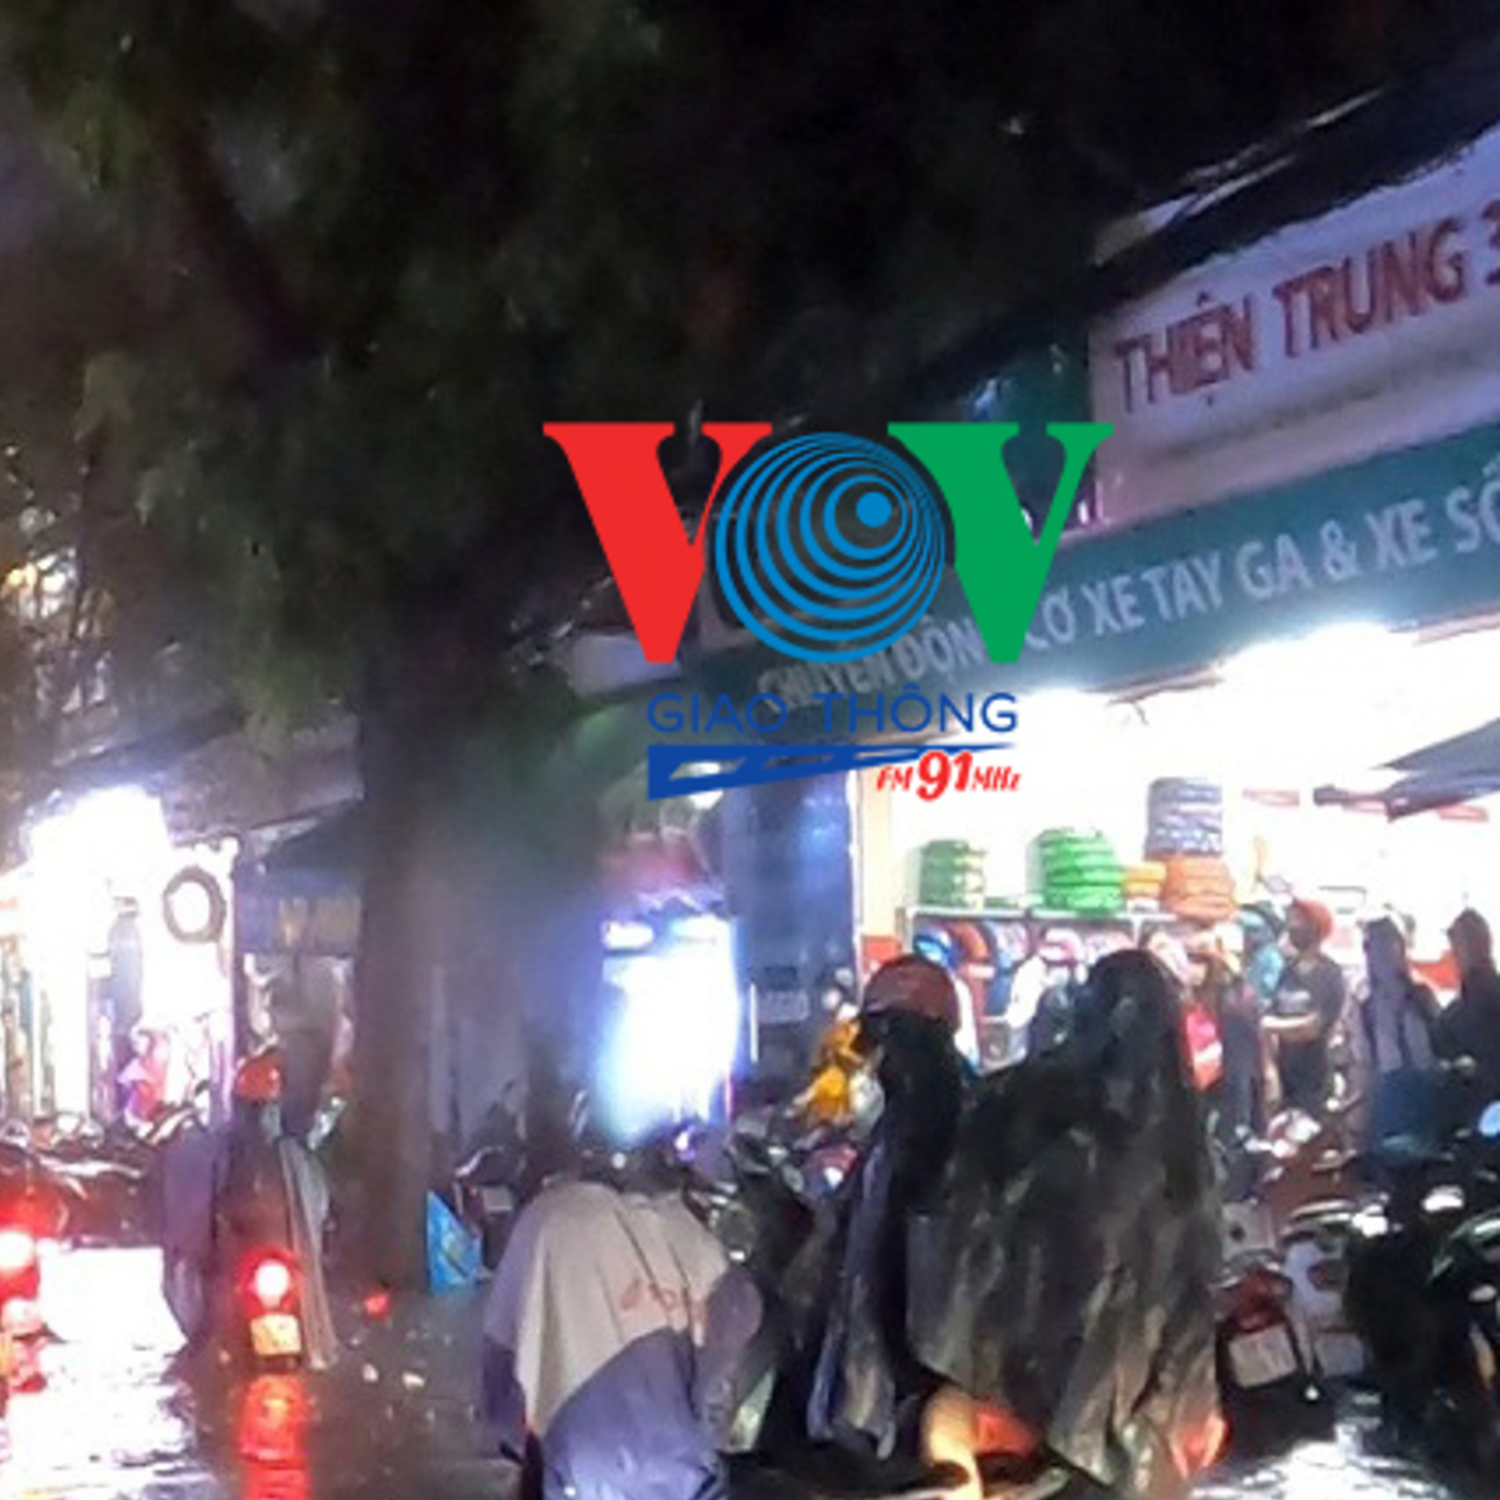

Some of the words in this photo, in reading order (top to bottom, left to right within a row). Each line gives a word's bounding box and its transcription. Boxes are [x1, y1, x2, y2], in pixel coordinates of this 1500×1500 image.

[1114, 291, 1255, 415] THIỆN
[1272, 216, 1468, 359] TRUNG
[1082, 575, 1145, 636] XE
[1140, 548, 1225, 622] TAY
[1236, 533, 1313, 599] GA
[1319, 519, 1360, 582] &
[1365, 500, 1438, 570] XE
